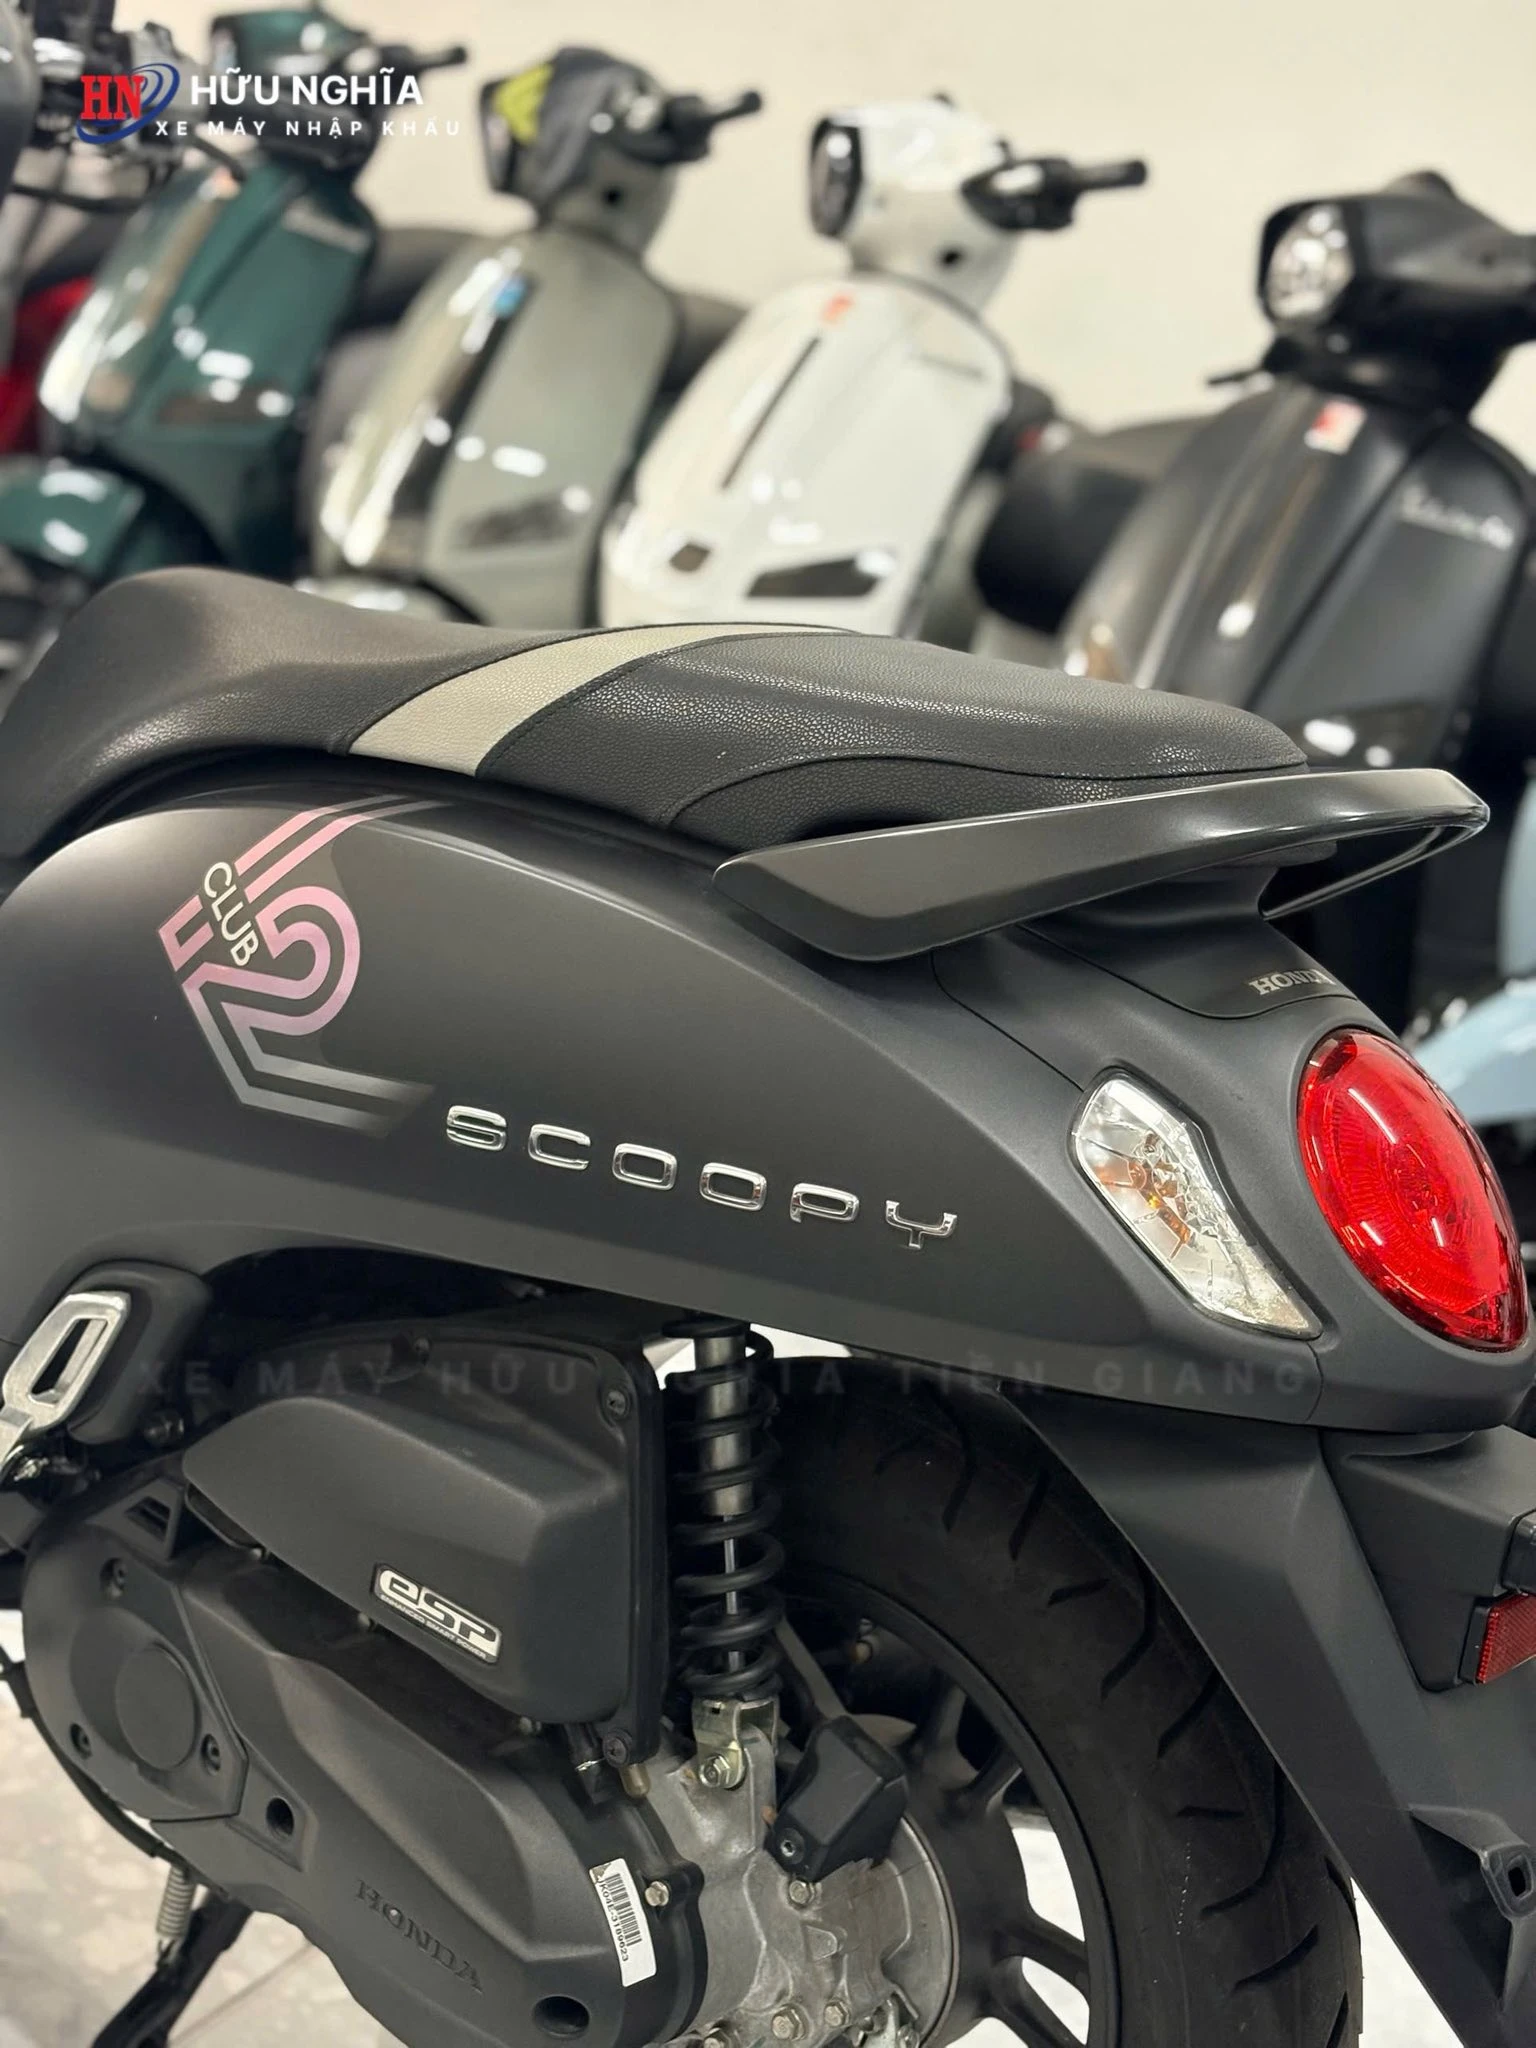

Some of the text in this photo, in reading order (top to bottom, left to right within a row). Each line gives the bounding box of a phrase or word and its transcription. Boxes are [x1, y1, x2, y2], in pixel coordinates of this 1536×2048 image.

[204, 861, 259, 967] CLUB
[1248, 968, 1337, 996] HONDA
[446, 1104, 958, 1250] SCOOPY
[355, 1879, 485, 1994] HONDA
